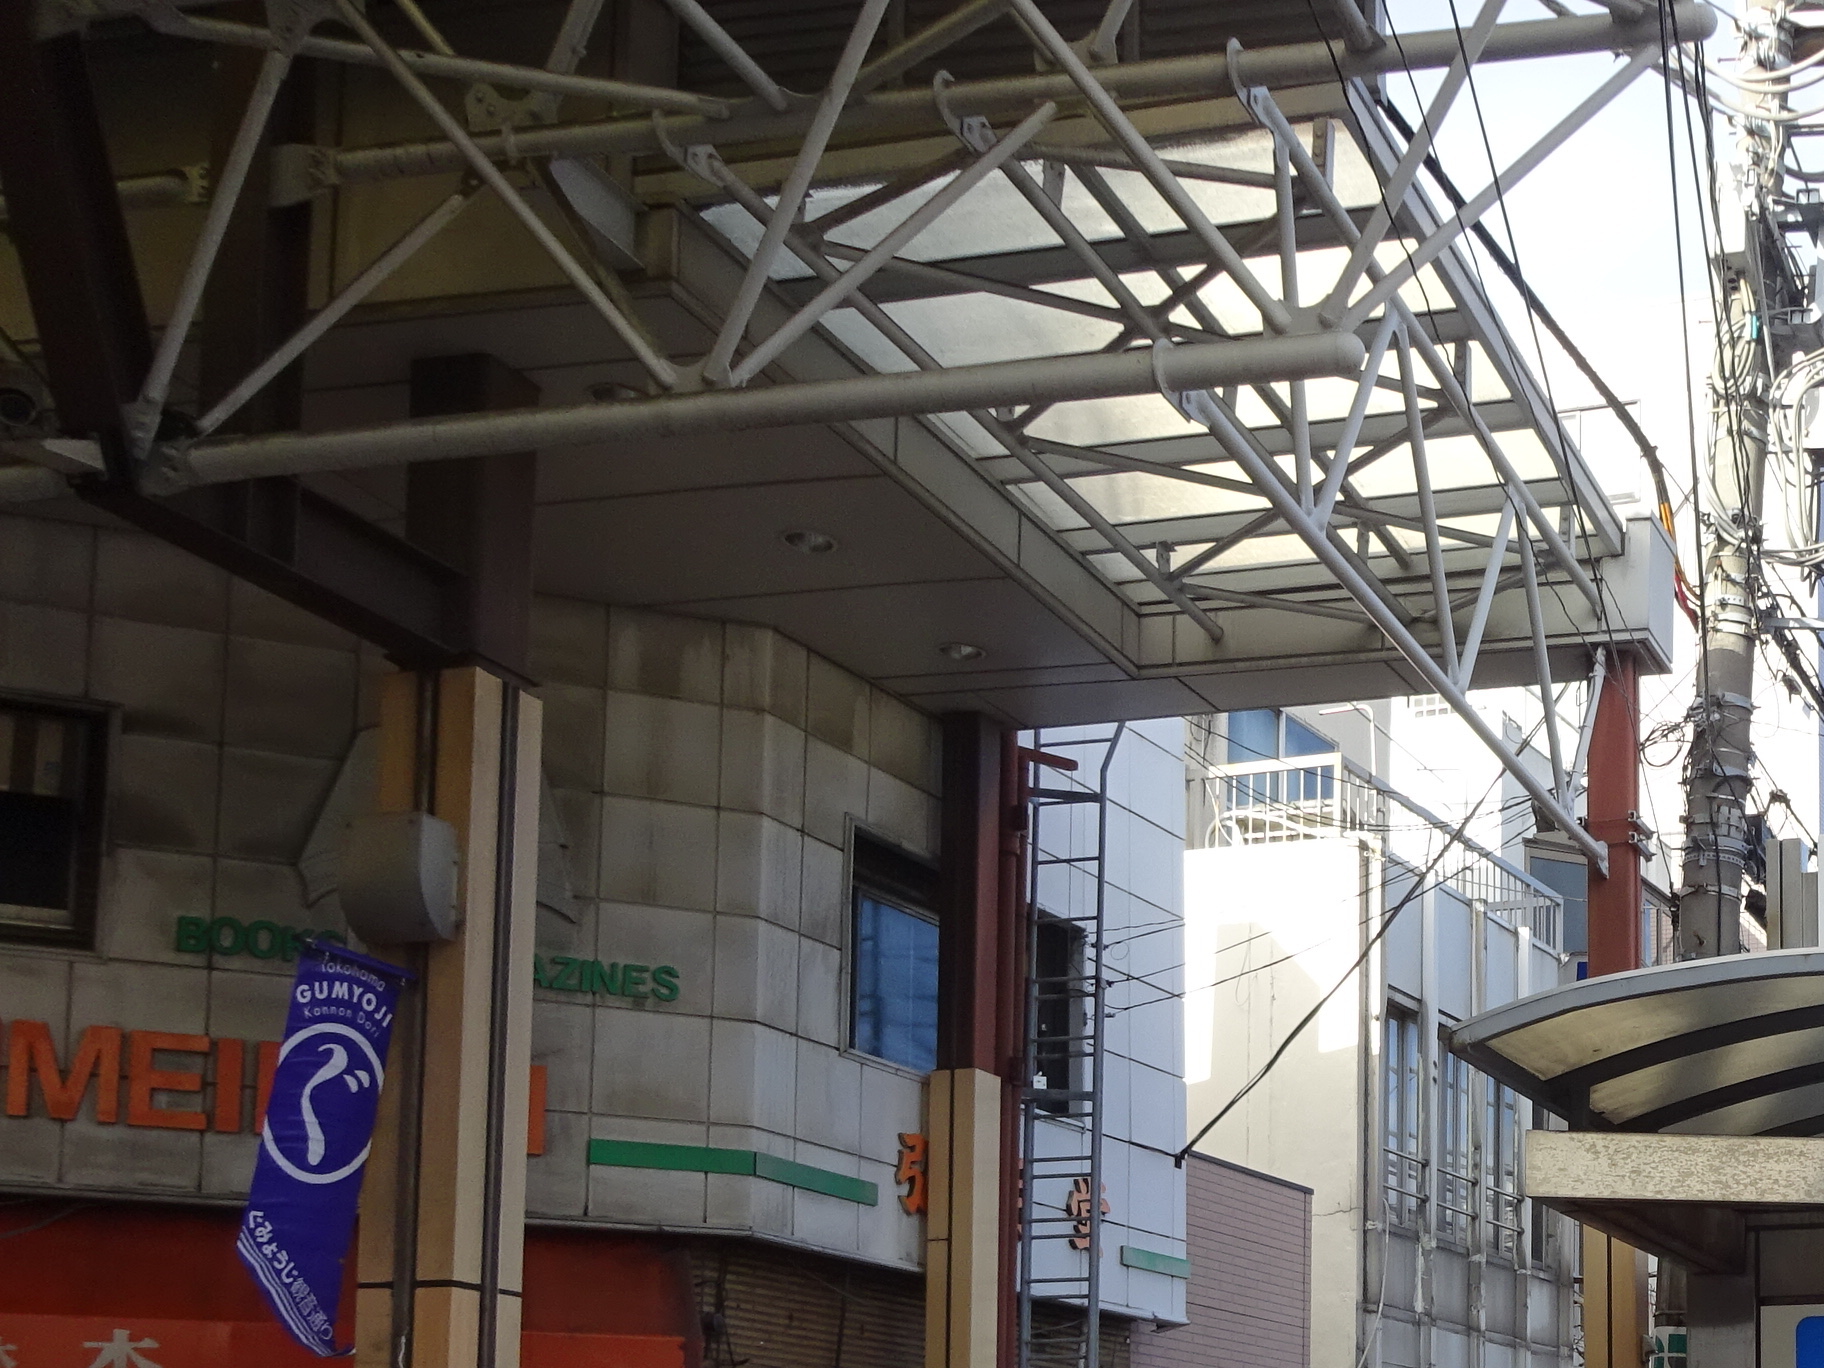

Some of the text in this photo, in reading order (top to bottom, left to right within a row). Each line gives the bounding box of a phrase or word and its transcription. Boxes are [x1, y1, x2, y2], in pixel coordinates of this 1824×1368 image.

[295, 980, 393, 1028] GUMYOJI
[303, 1005, 380, 1038] Kannon Dori
